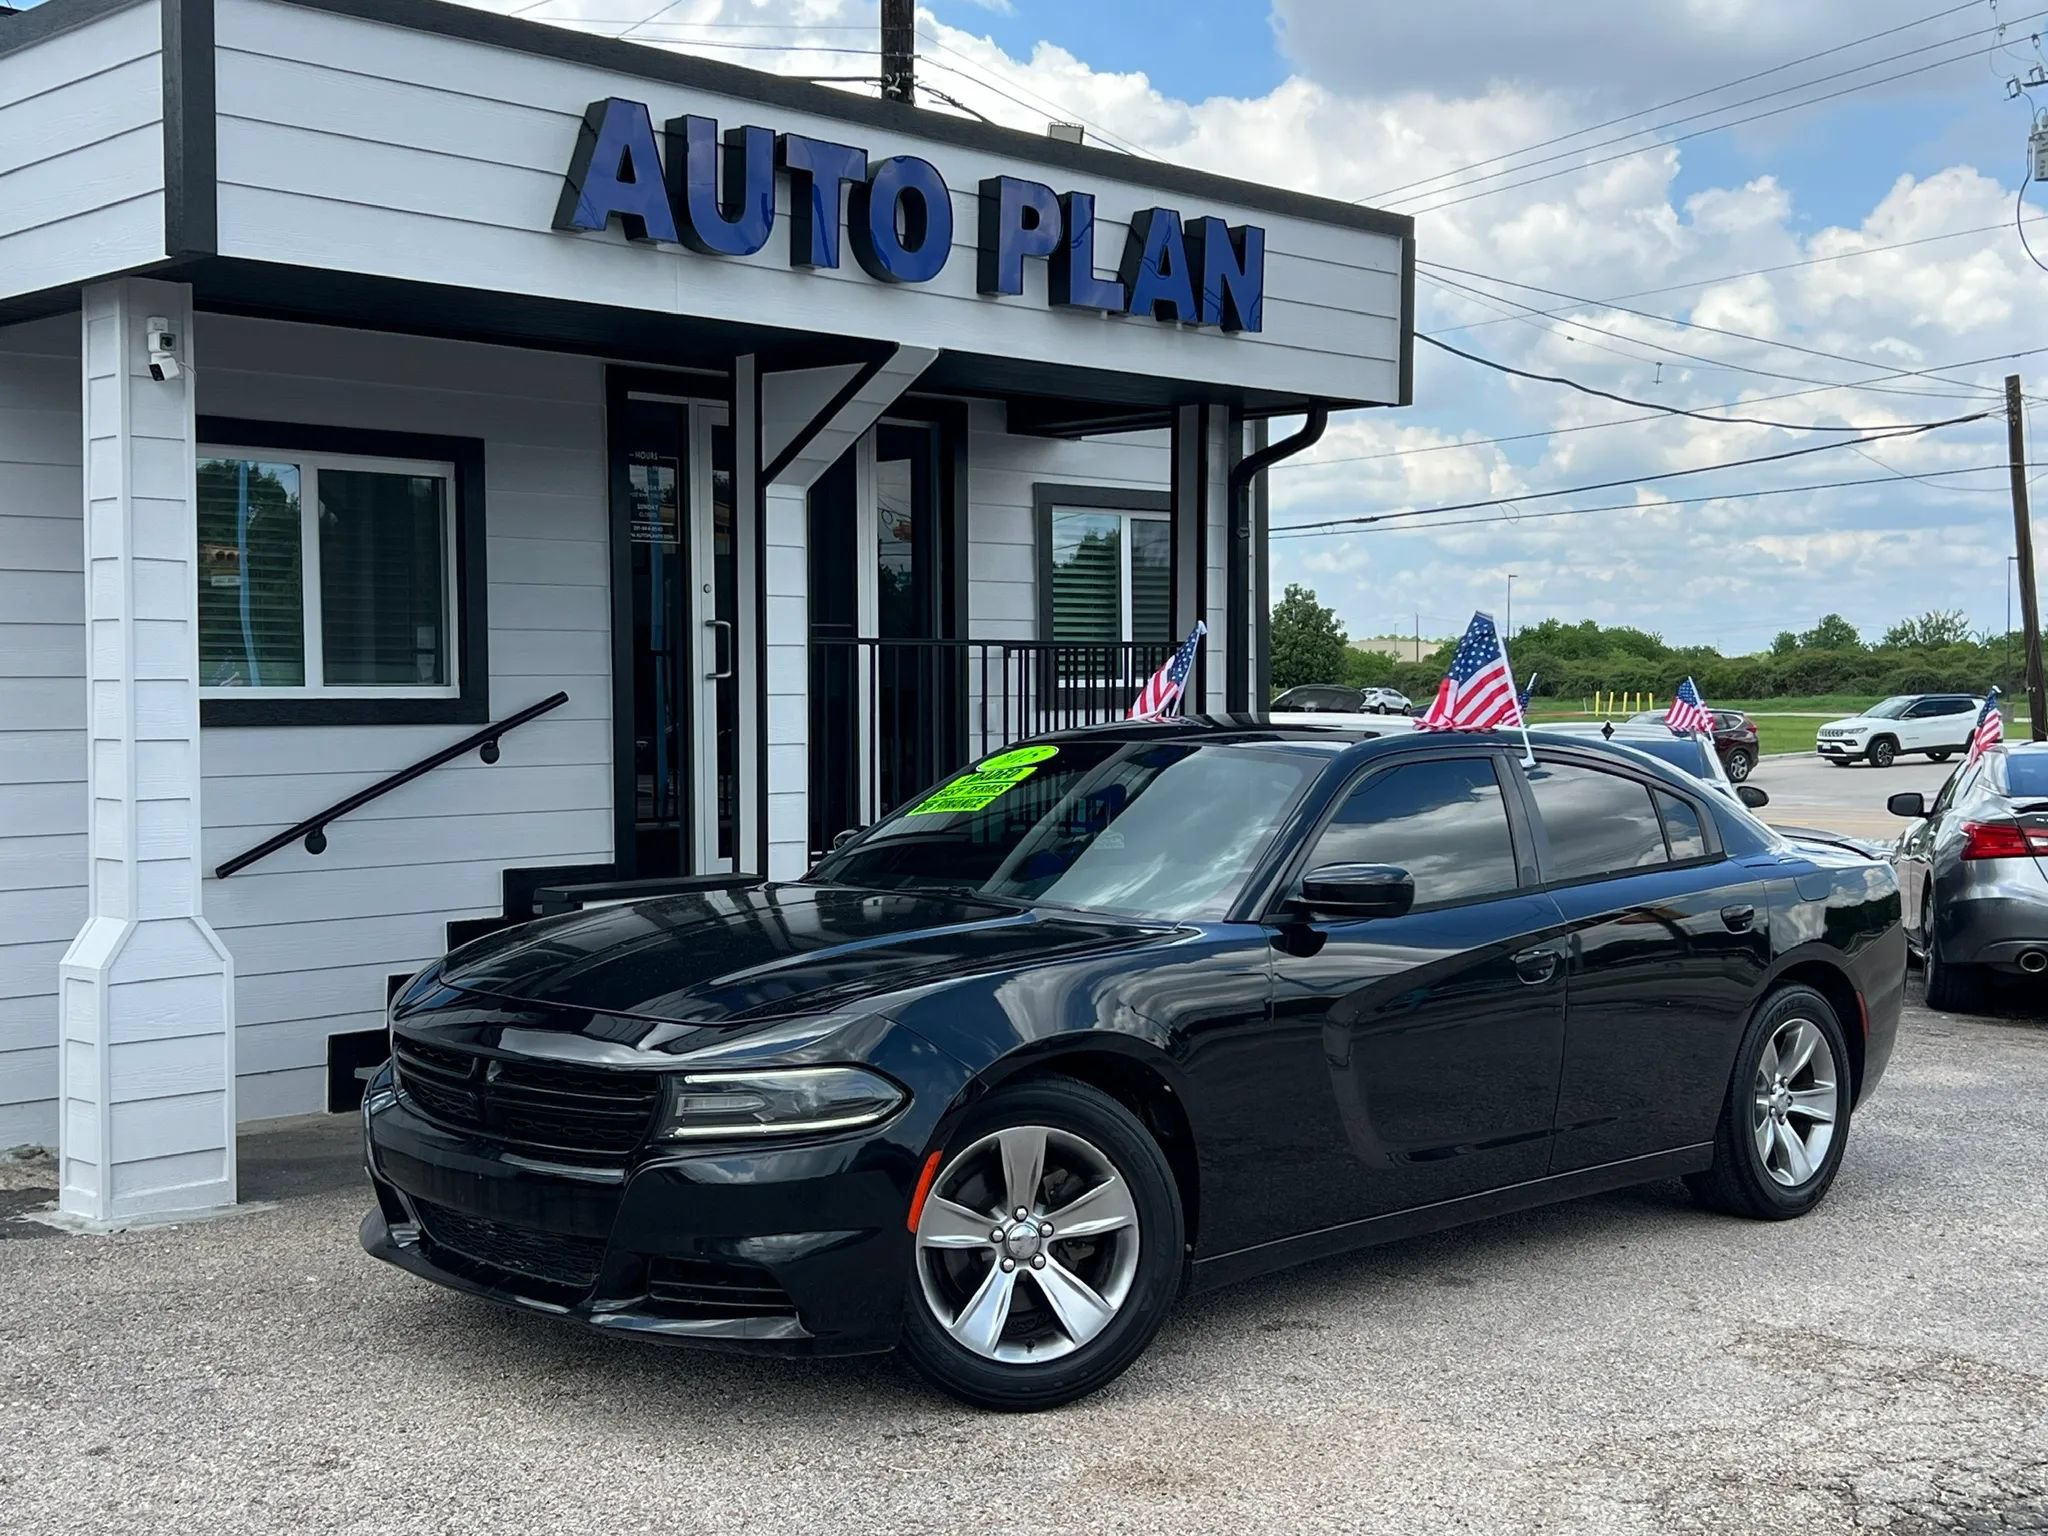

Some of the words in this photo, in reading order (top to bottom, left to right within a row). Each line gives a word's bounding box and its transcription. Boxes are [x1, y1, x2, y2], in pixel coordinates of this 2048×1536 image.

[552, 97, 953, 284] AUTO
[977, 174, 1266, 333] PLAN
[960, 768, 1022, 784] LOADED
